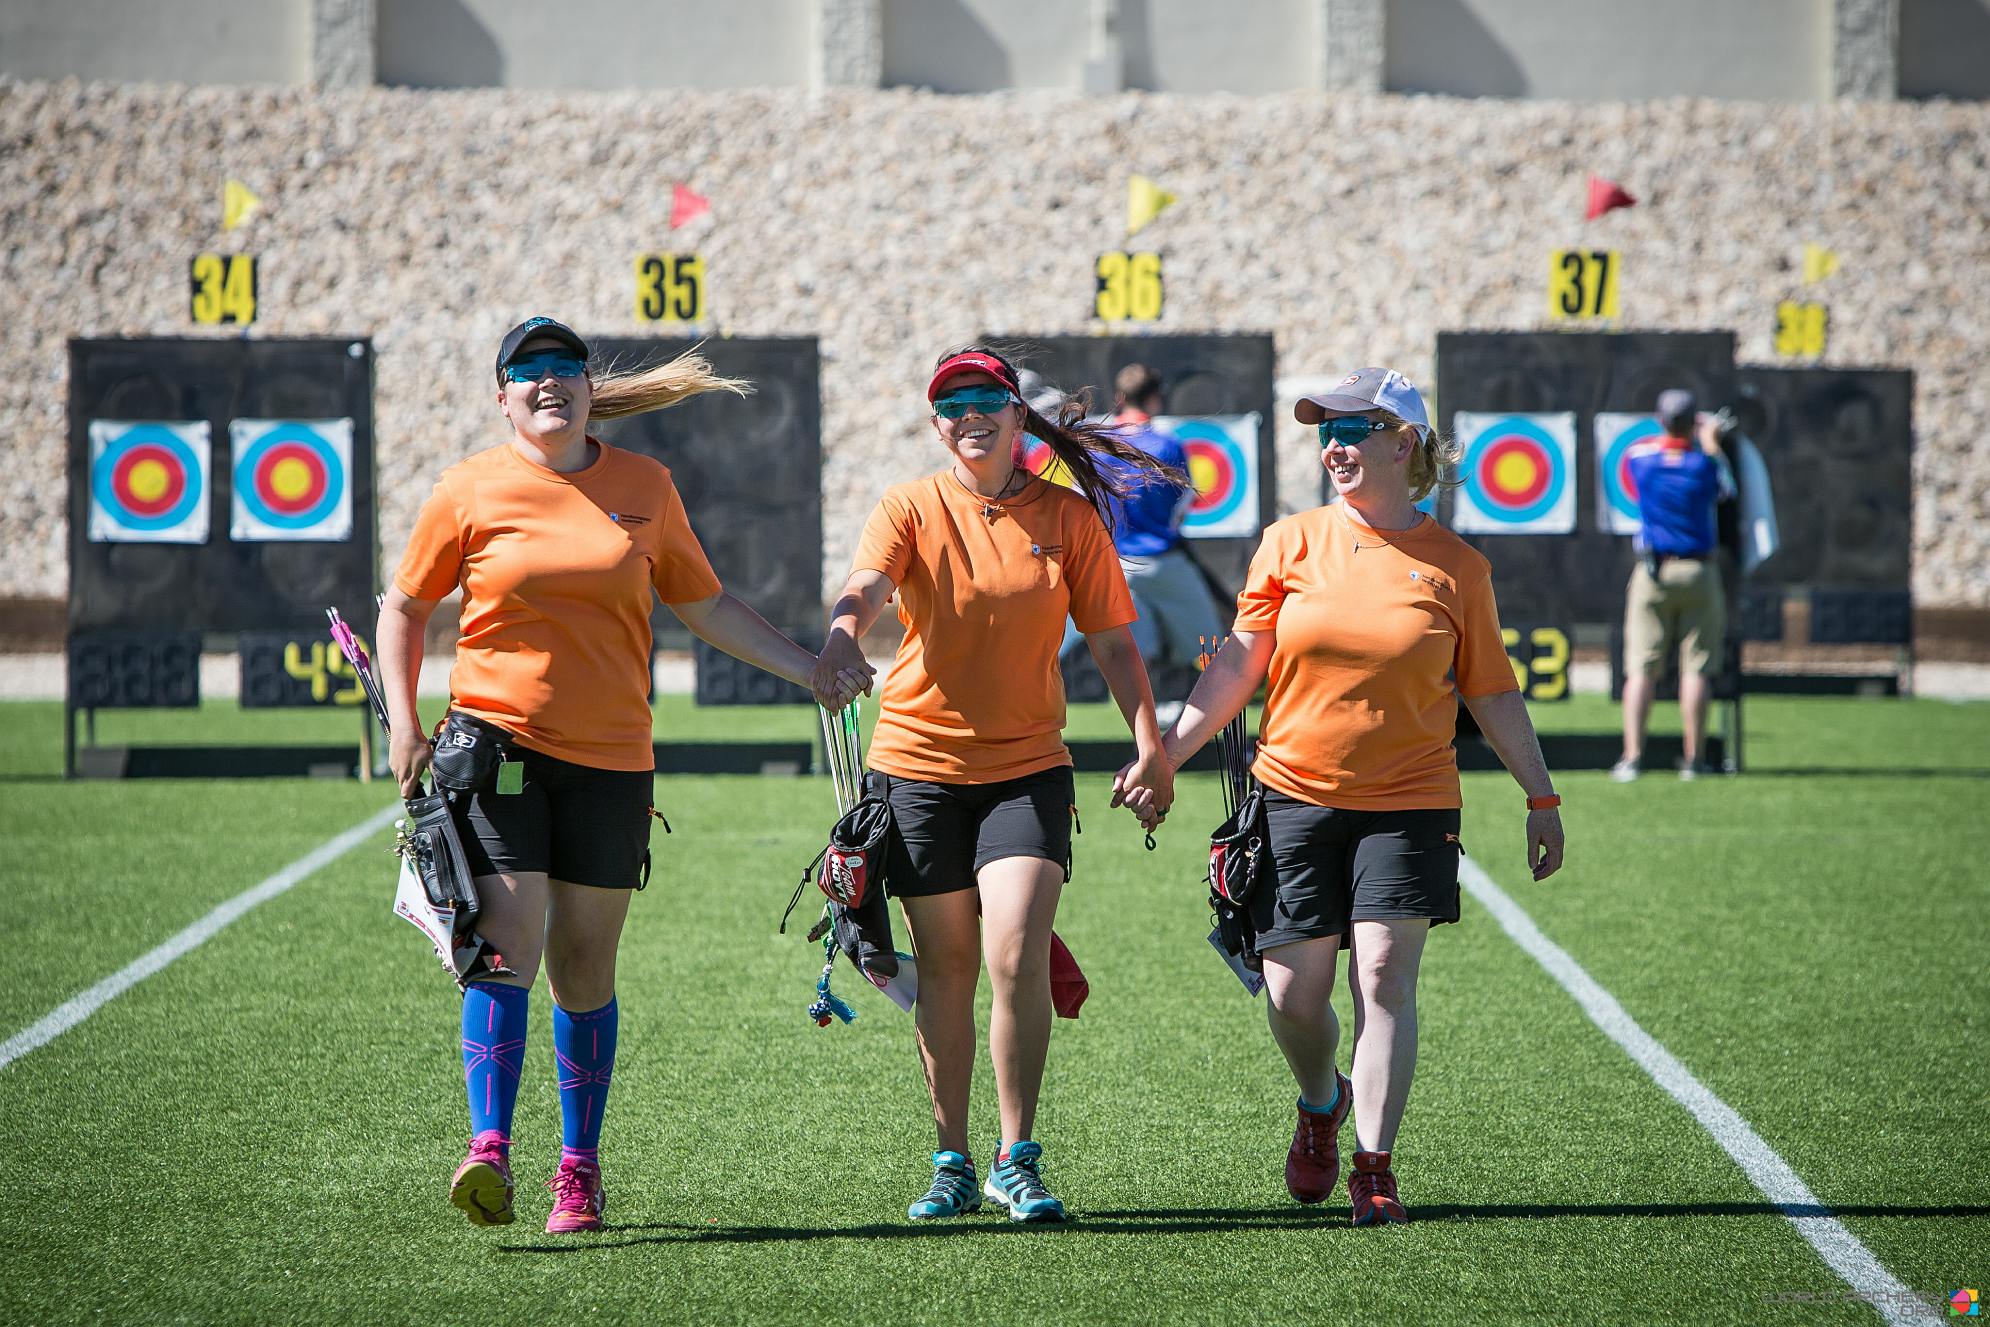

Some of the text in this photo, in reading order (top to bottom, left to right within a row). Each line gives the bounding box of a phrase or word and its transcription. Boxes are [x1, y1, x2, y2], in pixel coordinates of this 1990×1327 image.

[194, 253, 256, 323] 34
[643, 256, 698, 320] 35
[1101, 252, 1166, 321] 36
[1562, 253, 1609, 315] 37
